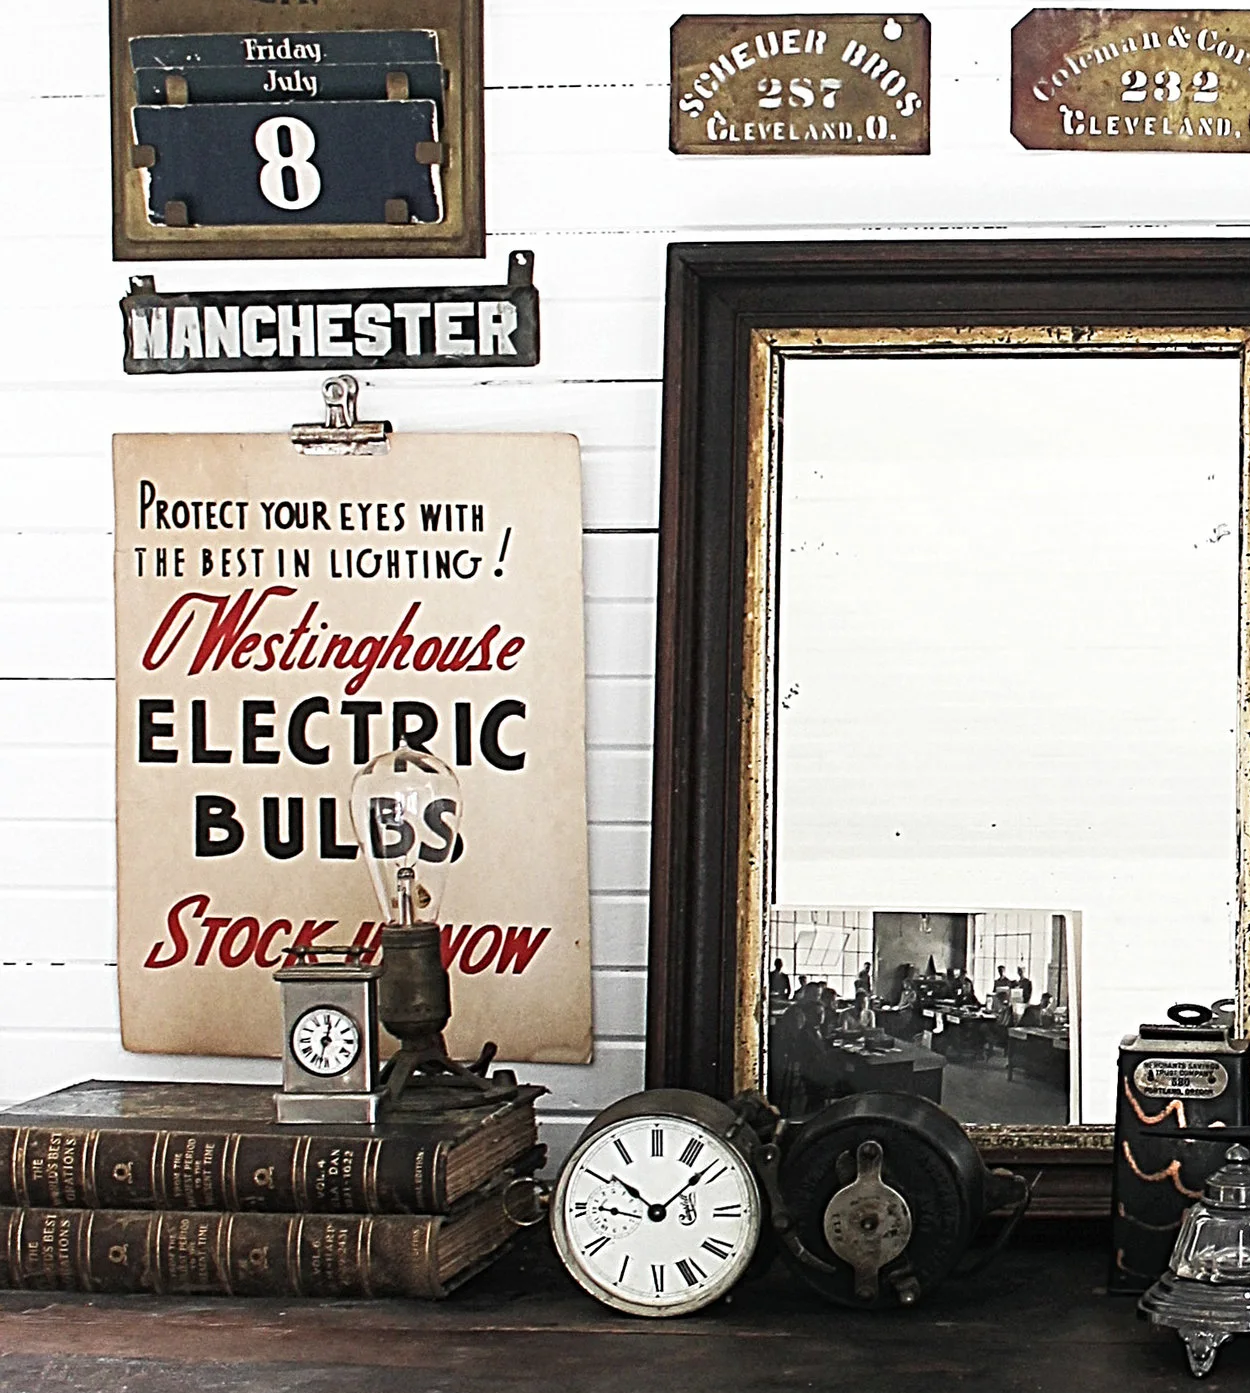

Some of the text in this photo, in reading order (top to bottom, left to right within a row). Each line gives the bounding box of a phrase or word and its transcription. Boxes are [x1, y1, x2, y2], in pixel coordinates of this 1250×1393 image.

[679, 29, 922, 117] SCHEUER BROS
[1033, 31, 1161, 101] Coleman
[1168, 26, 1191, 48] &
[263, 70, 317, 96] July
[758, 78, 842, 109] 287
[1121, 70, 1219, 102] 232
[866, 115, 897, 141] O.
[254, 115, 321, 209] 8
[131, 301, 518, 359] MANCHESTER
[260, 501, 331, 531] YOUR
[340, 503, 405, 532] EYES
[421, 504, 484, 532] WITH
[134, 547, 184, 577] THE
[202, 548, 264, 578] BEST
[278, 549, 310, 578] IN
[141, 585, 525, 696] Westinghouse
[137, 695, 526, 771] ELECTRIC
[194, 794, 464, 864] BULBS
[144, 894, 338, 969] STOCK
[47, 1132, 62, 1160] BEST
[184, 1138, 196, 1170] PERIOD
[203, 1143, 215, 1164] TIME
[32, 1159, 43, 1179] THE
[63, 1138, 77, 1200] ORATIONS
[43, 1215, 57, 1242] BEST
[28, 1242, 38, 1262] THE
